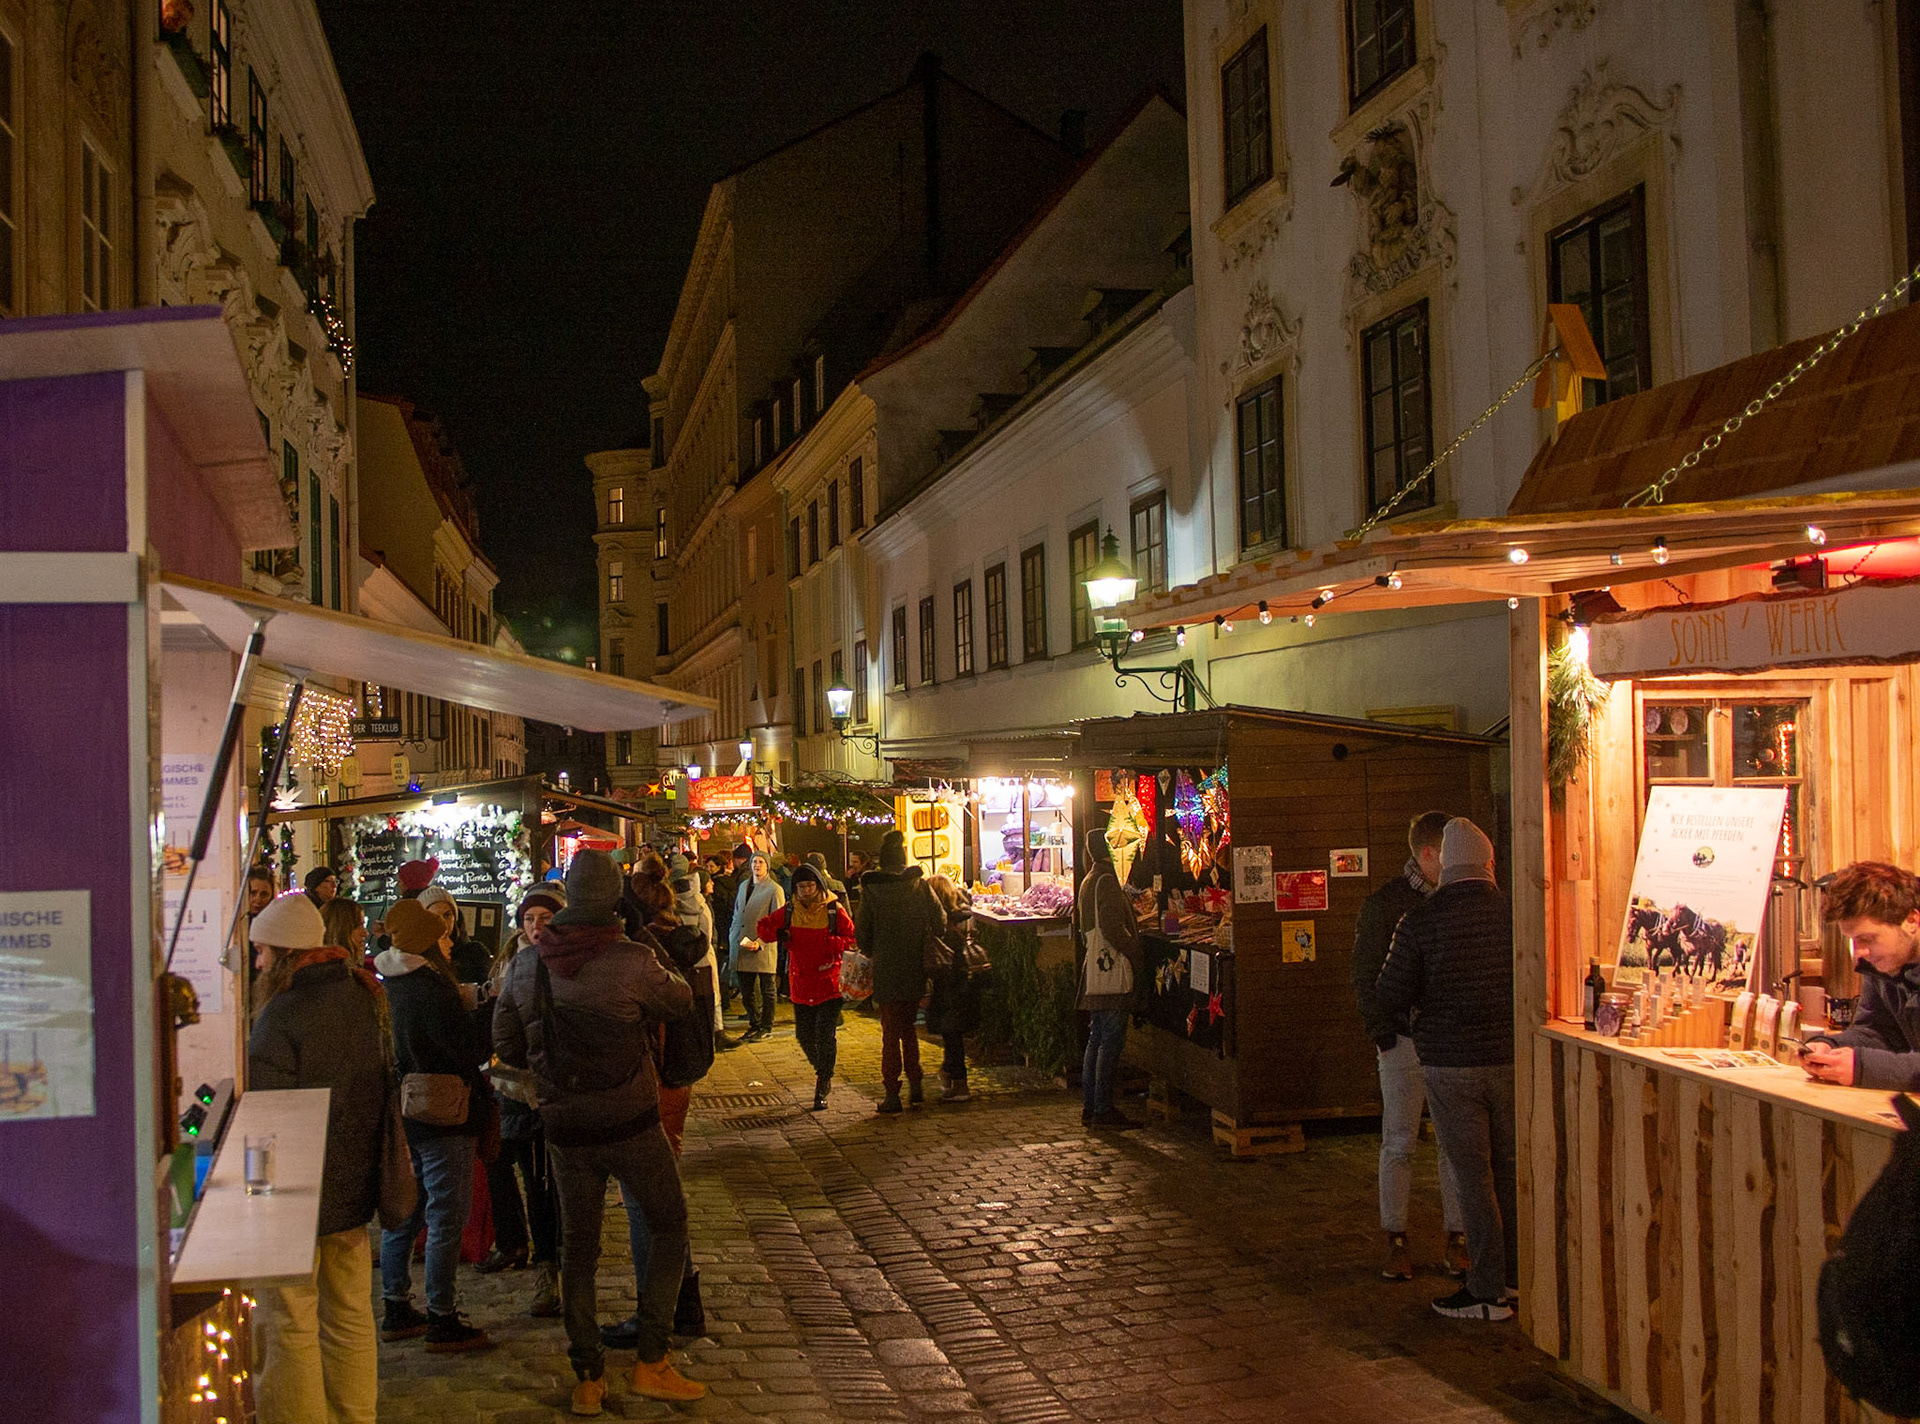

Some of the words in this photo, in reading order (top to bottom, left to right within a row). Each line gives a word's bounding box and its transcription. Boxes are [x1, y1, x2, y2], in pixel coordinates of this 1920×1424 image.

[1766, 597, 1847, 657] WERK
[353, 724, 366, 733] DER
[371, 723, 399, 733] TEEKLUB
[1685, 814, 1724, 827] BESTELLEN
[1725, 816, 1754, 829] UNSERE
[1694, 829, 1710, 840] MIT
[471, 884, 497, 895] Punsch
